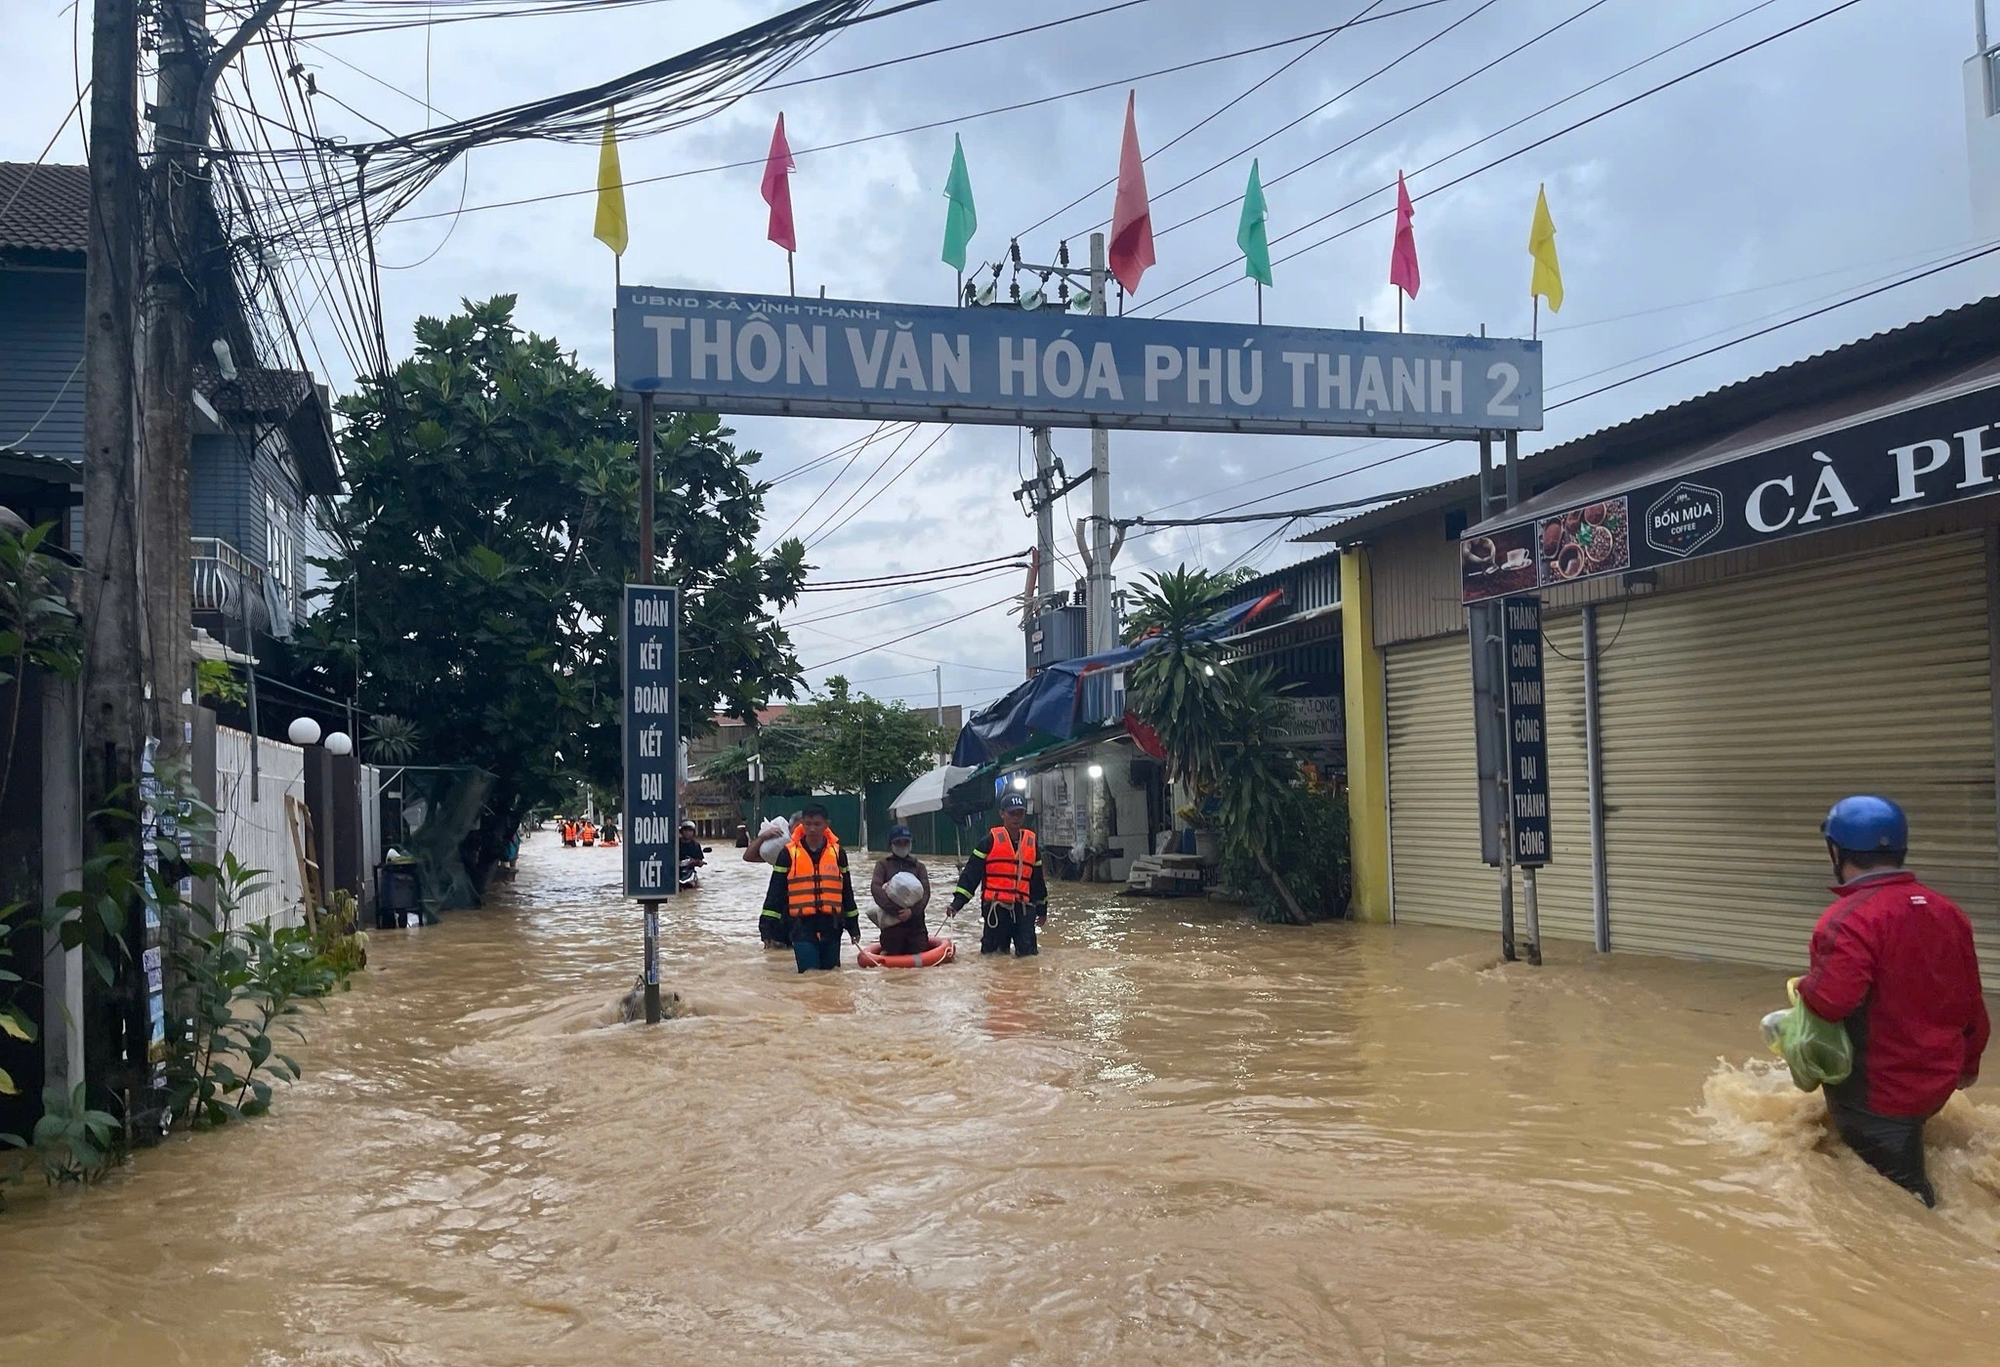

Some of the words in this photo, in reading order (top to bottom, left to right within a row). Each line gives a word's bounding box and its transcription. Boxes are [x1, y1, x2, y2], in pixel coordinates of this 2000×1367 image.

[632, 295, 700, 309] UBND
[706, 297, 742, 311] XÃ
[804, 305, 880, 321] THẠNH
[643, 311, 828, 387] THÔN
[845, 321, 971, 394] VĂN
[999, 328, 1124, 401] HÓA
[1145, 338, 1263, 407] PHÚ
[1282, 351, 1463, 418] THẠNH
[1486, 362, 1520, 418] 2
[1745, 451, 1859, 533] CÀ
[1654, 508, 1679, 529] BỐN
[1682, 502, 1713, 521] MÙA
[1671, 522, 1696, 535] COFFEE
[634, 594, 669, 627] ĐOÀN
[1508, 602, 1538, 630] THÀNH
[640, 635, 663, 670] KẾT
[1512, 641, 1537, 668] CÔNG
[634, 681, 669, 714] ĐOÀN
[1511, 679, 1542, 705] THÀNH
[640, 722, 663, 757] KẾT
[1515, 714, 1540, 743] CÔNG
[1520, 756, 1537, 784] ĐẠI
[641, 773, 663, 806] ĐẠI
[1515, 790, 1546, 818] THÀNH
[634, 811, 669, 845] ĐOÀN
[1519, 826, 1545, 856] CÔNG
[640, 852, 663, 888] KẾT
